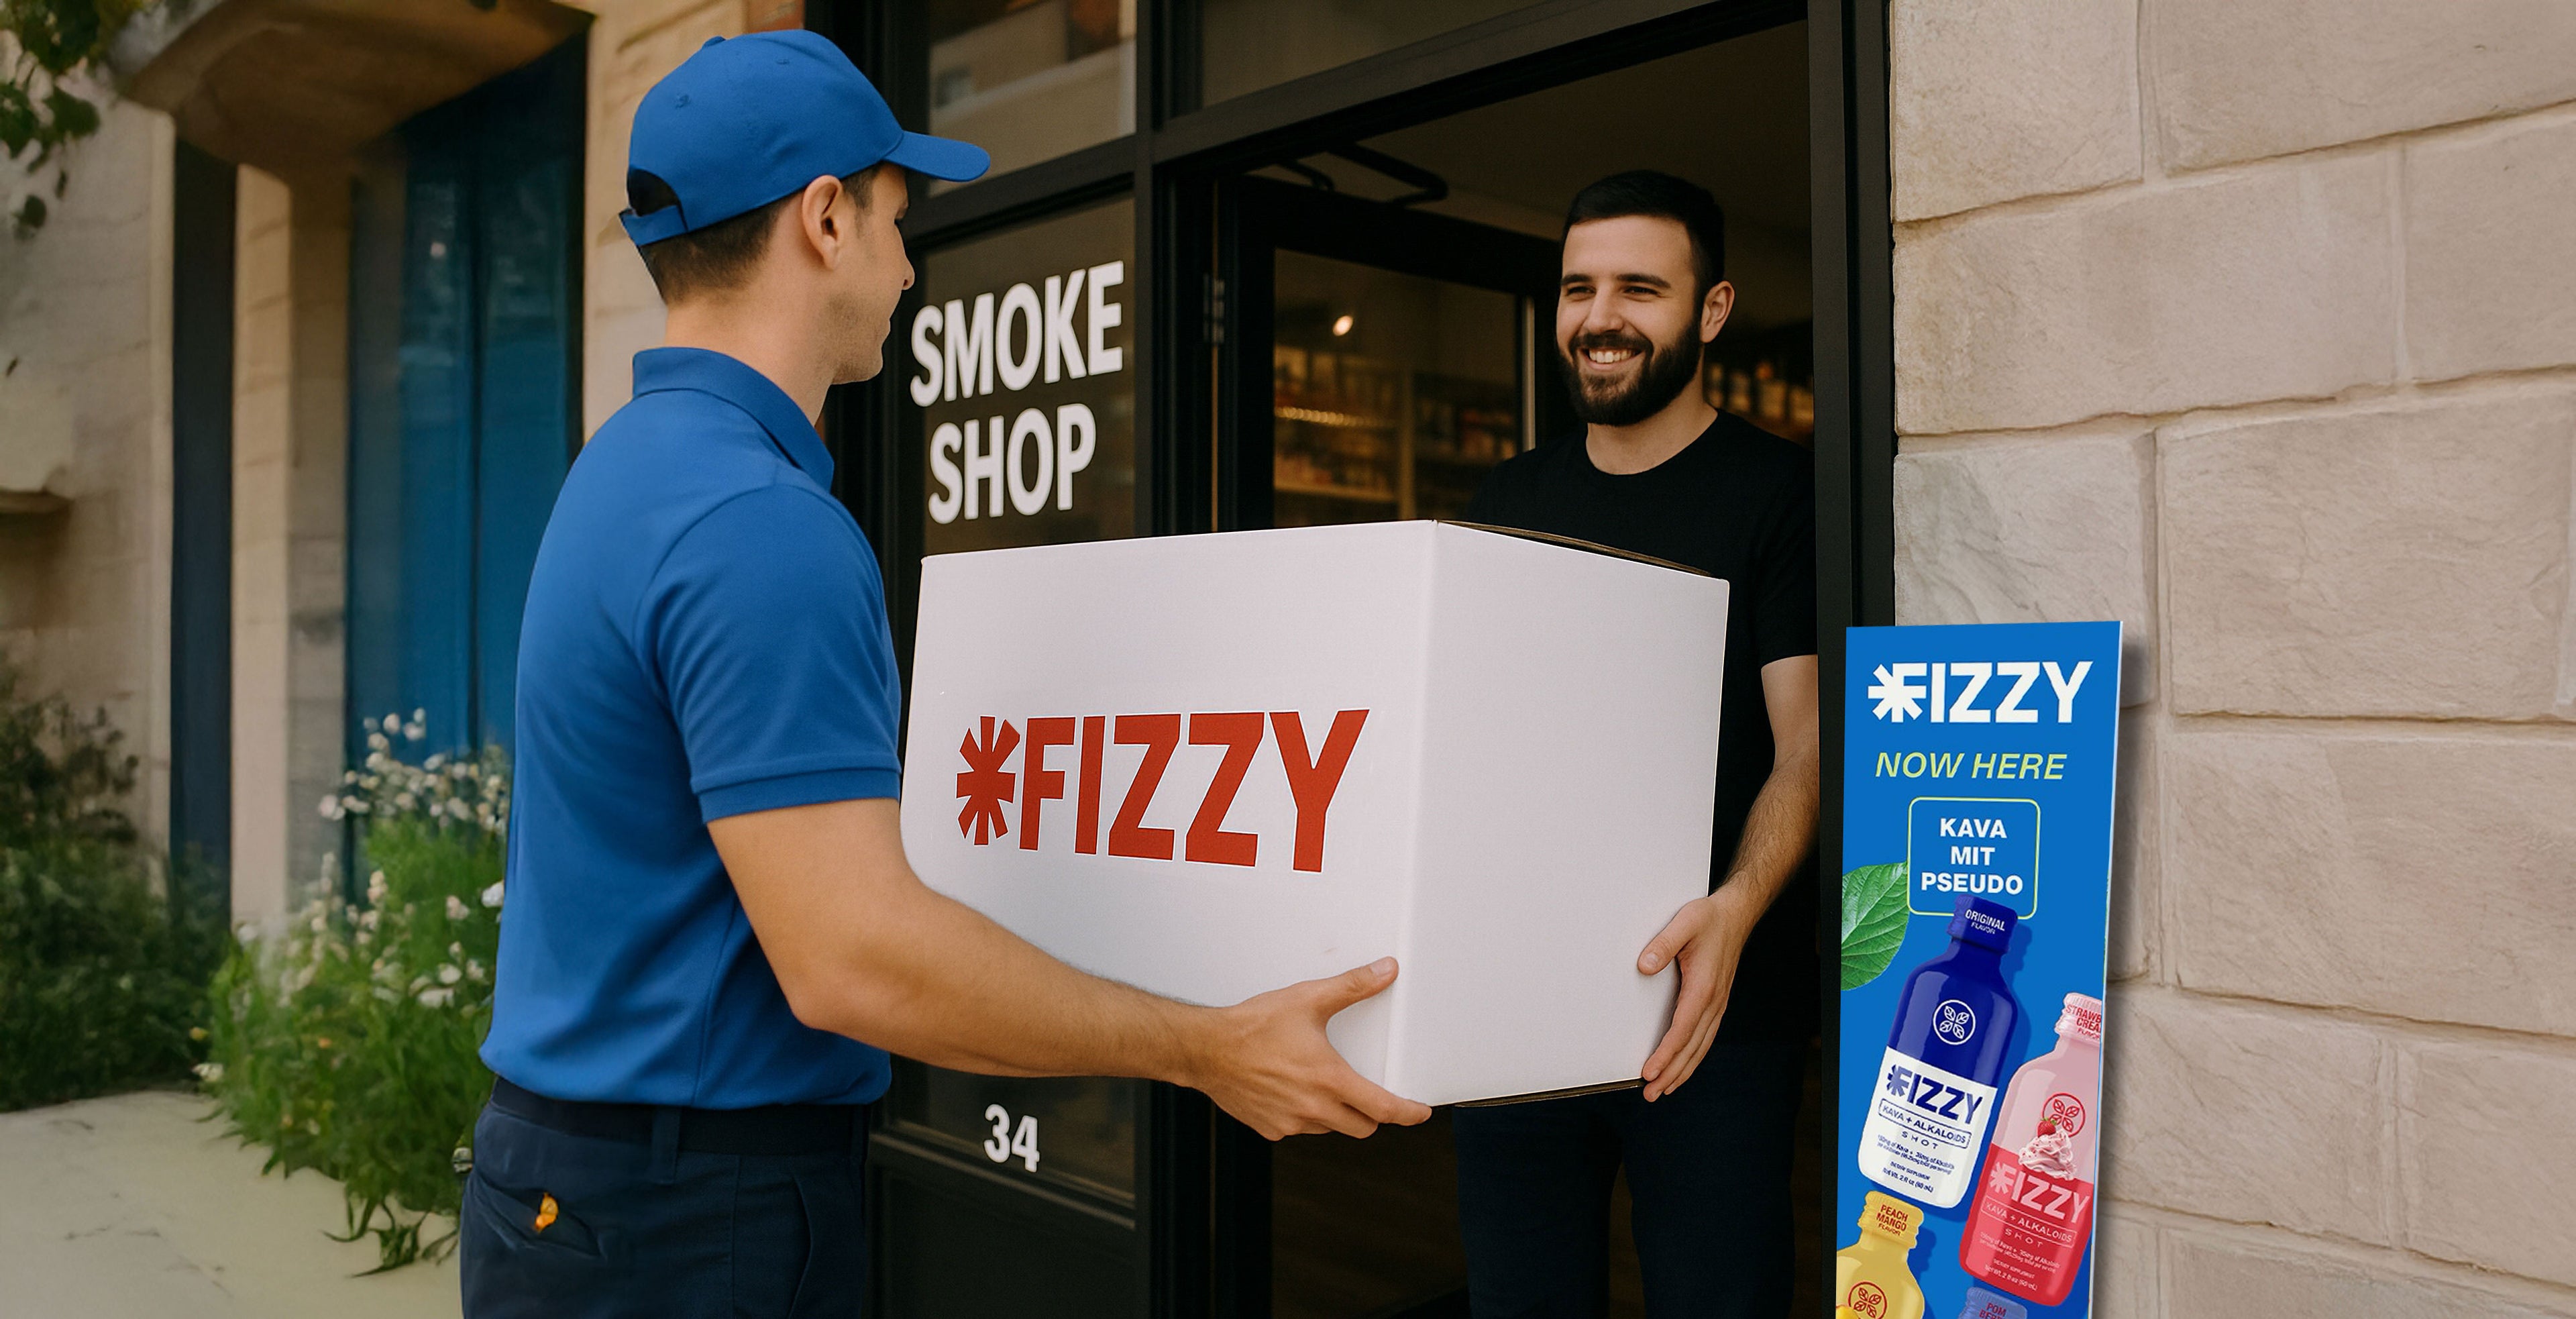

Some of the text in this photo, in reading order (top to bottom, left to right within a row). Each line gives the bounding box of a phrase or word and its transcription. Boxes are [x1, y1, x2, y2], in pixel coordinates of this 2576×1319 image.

[910, 260, 1124, 407] SMOKE
[928, 404, 1096, 525] SHOP
[1868, 661, 2094, 723] FIZZY
[1876, 752, 2068, 780] NOW HERE
[1019, 709, 1370, 873] FIZZY
[1940, 818, 2007, 839] KAVA
[1950, 846, 1995, 865] MIT
[1921, 873, 2023, 895] PSEUDO
[1965, 909, 2005, 931] ORIGINAL
[2077, 1017, 2101, 1033] CREA
[1886, 1064, 1983, 1124] FIZZY
[1882, 1105, 1904, 1121] KAVA
[1913, 1120, 1966, 1143] ALKALOIDS
[984, 1104, 1040, 1172] 34
[1901, 1130, 1939, 1149] SHOT
[1990, 1161, 2090, 1223] FIZZY
[1876, 1212, 1907, 1232] MANGO
[1880, 1204, 1909, 1222] PEACH
[1986, 1202, 2007, 1218] KAVA
[2018, 1218, 2072, 1243] ALKALOIDS
[2004, 1227, 2043, 1248] SHOT
[1986, 1302, 2006, 1318] POM
